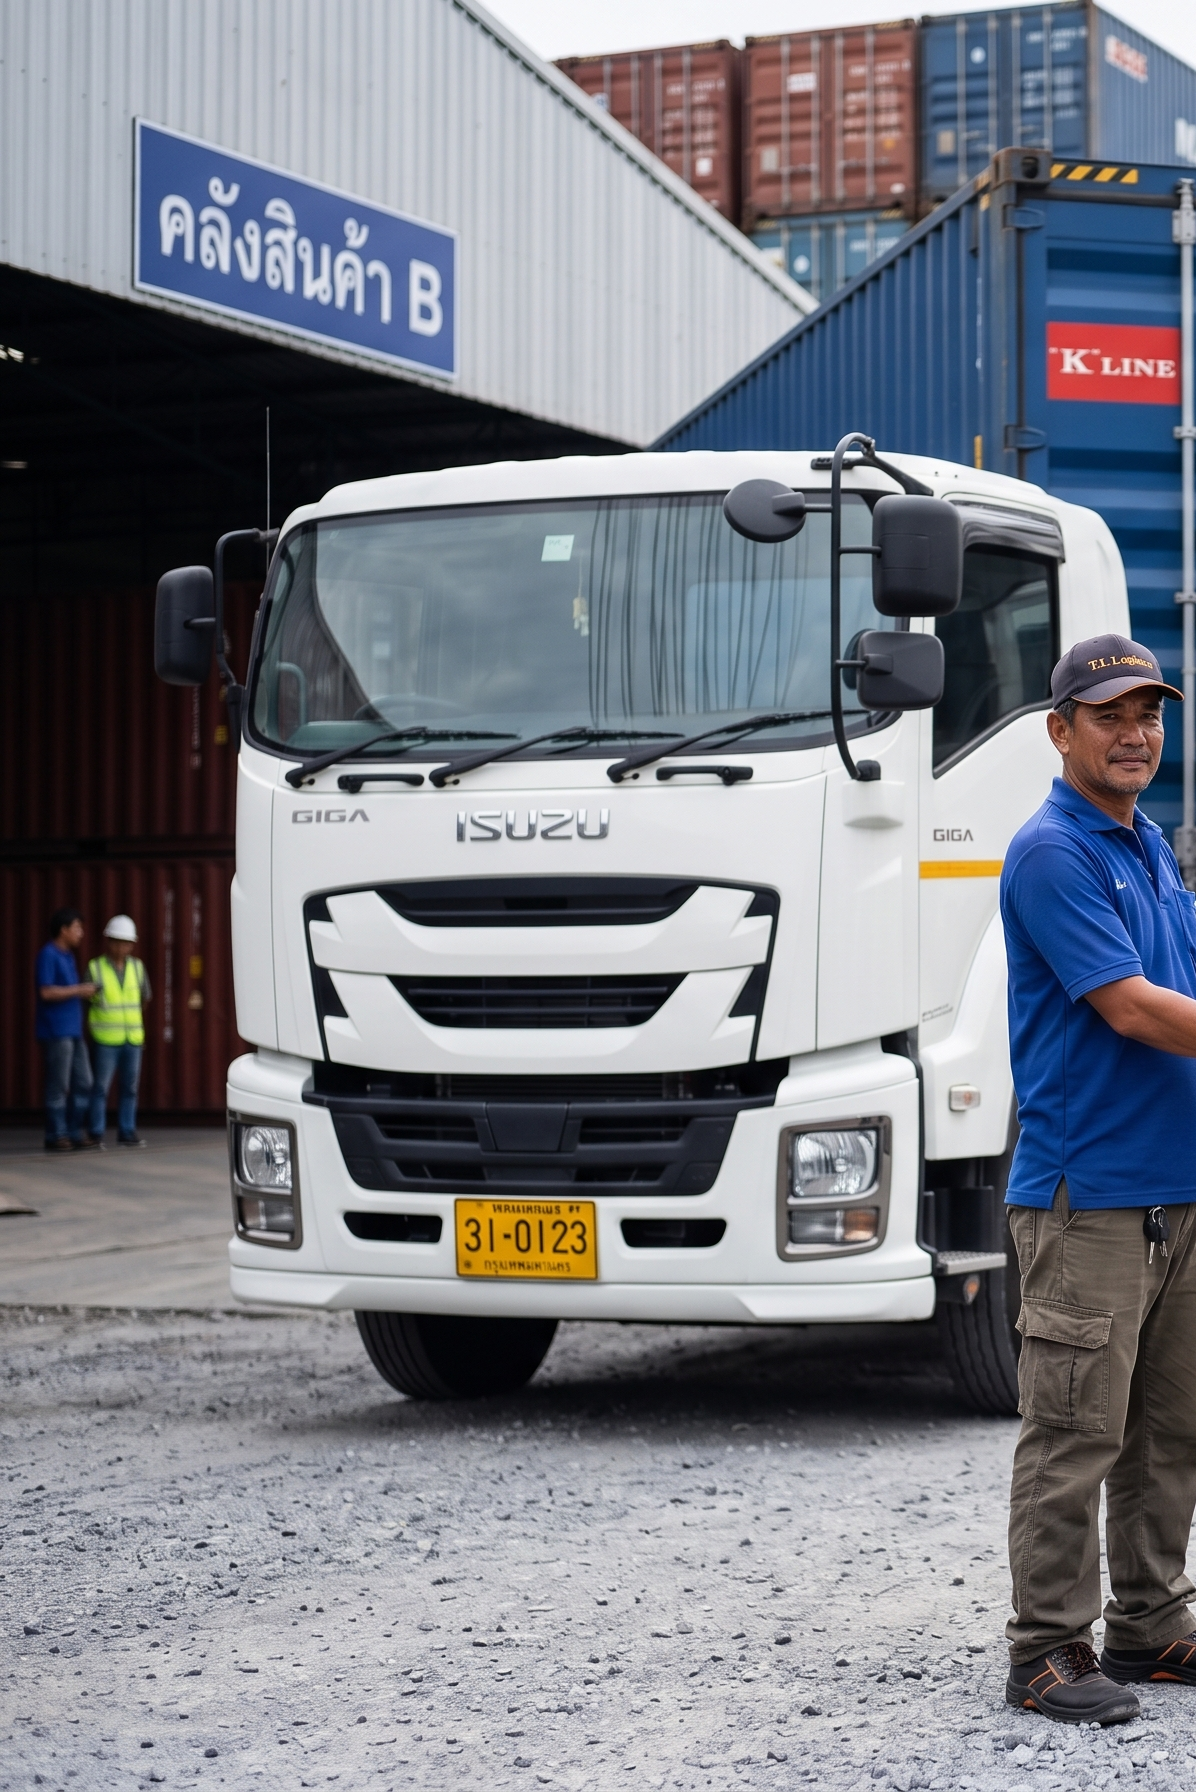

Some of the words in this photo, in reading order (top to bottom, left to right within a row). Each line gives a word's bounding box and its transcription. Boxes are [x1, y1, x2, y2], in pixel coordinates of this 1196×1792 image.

[159, 176, 392, 325] คลังสินค้า
[408, 258, 443, 338] B
[1100, 356, 1177, 379] LINE
[291, 808, 370, 824] GIGA
[456, 808, 610, 843] ISUZU
[933, 829, 974, 842] GIGA
[464, 1217, 587, 1255] 31-0123
